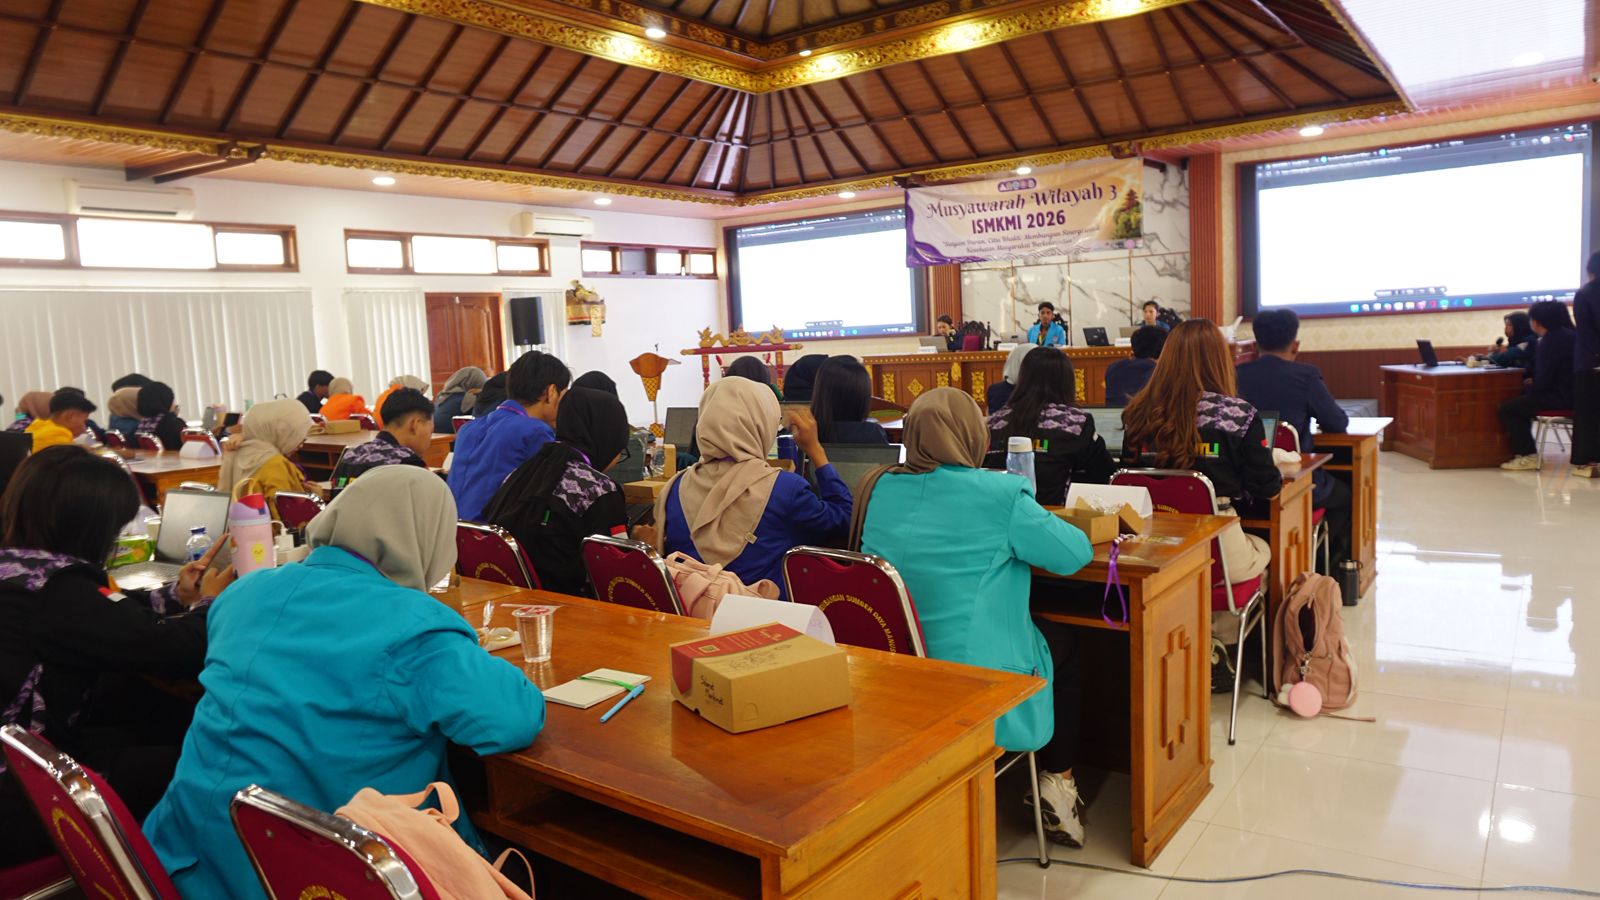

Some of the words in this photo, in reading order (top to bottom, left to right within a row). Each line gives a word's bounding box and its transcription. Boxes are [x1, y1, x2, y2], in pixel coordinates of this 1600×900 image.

[926, 194, 1025, 220] Musyawarah
[1030, 182, 1103, 207] Wilayah
[1109, 184, 1118, 201] 3
[972, 214, 1022, 235] ISMKMI
[1026, 210, 1066, 229] 2026
[872, 611, 887, 628] DAYA
[884, 627, 897, 655] MANUS
